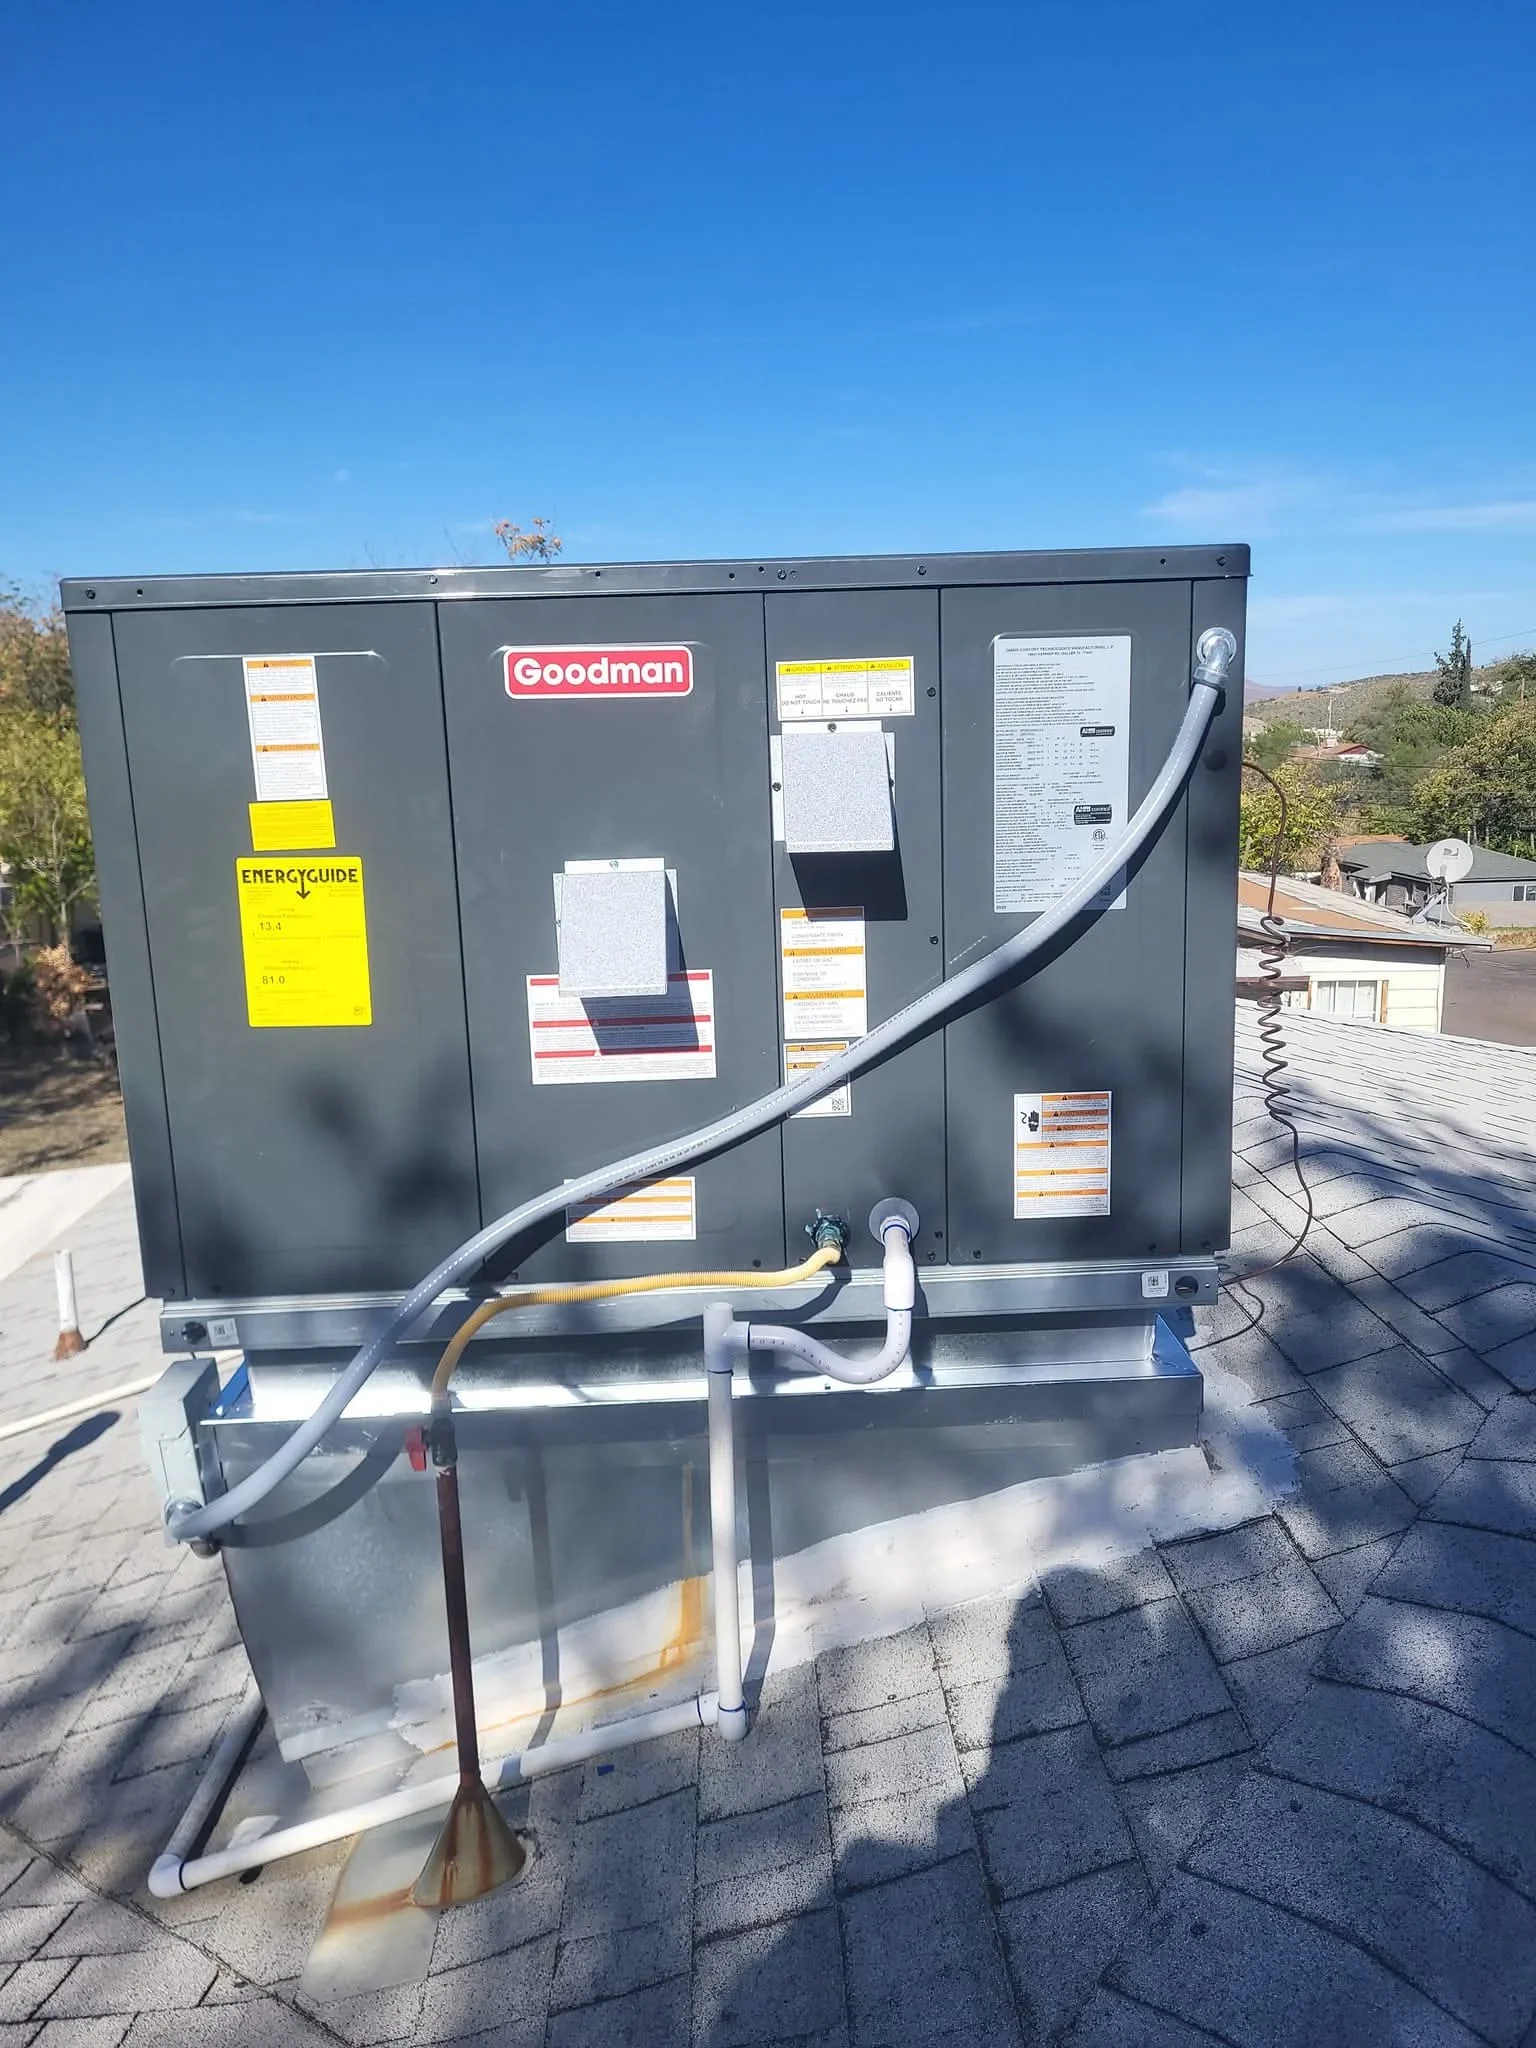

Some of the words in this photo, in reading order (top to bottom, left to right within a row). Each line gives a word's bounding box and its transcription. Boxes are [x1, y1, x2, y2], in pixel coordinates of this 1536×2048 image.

[514, 656, 684, 686] Goodman
[242, 868, 358, 886] ENERGYGUIDE
[259, 922, 282, 931] 13.4
[262, 975, 285, 985] 81.0
